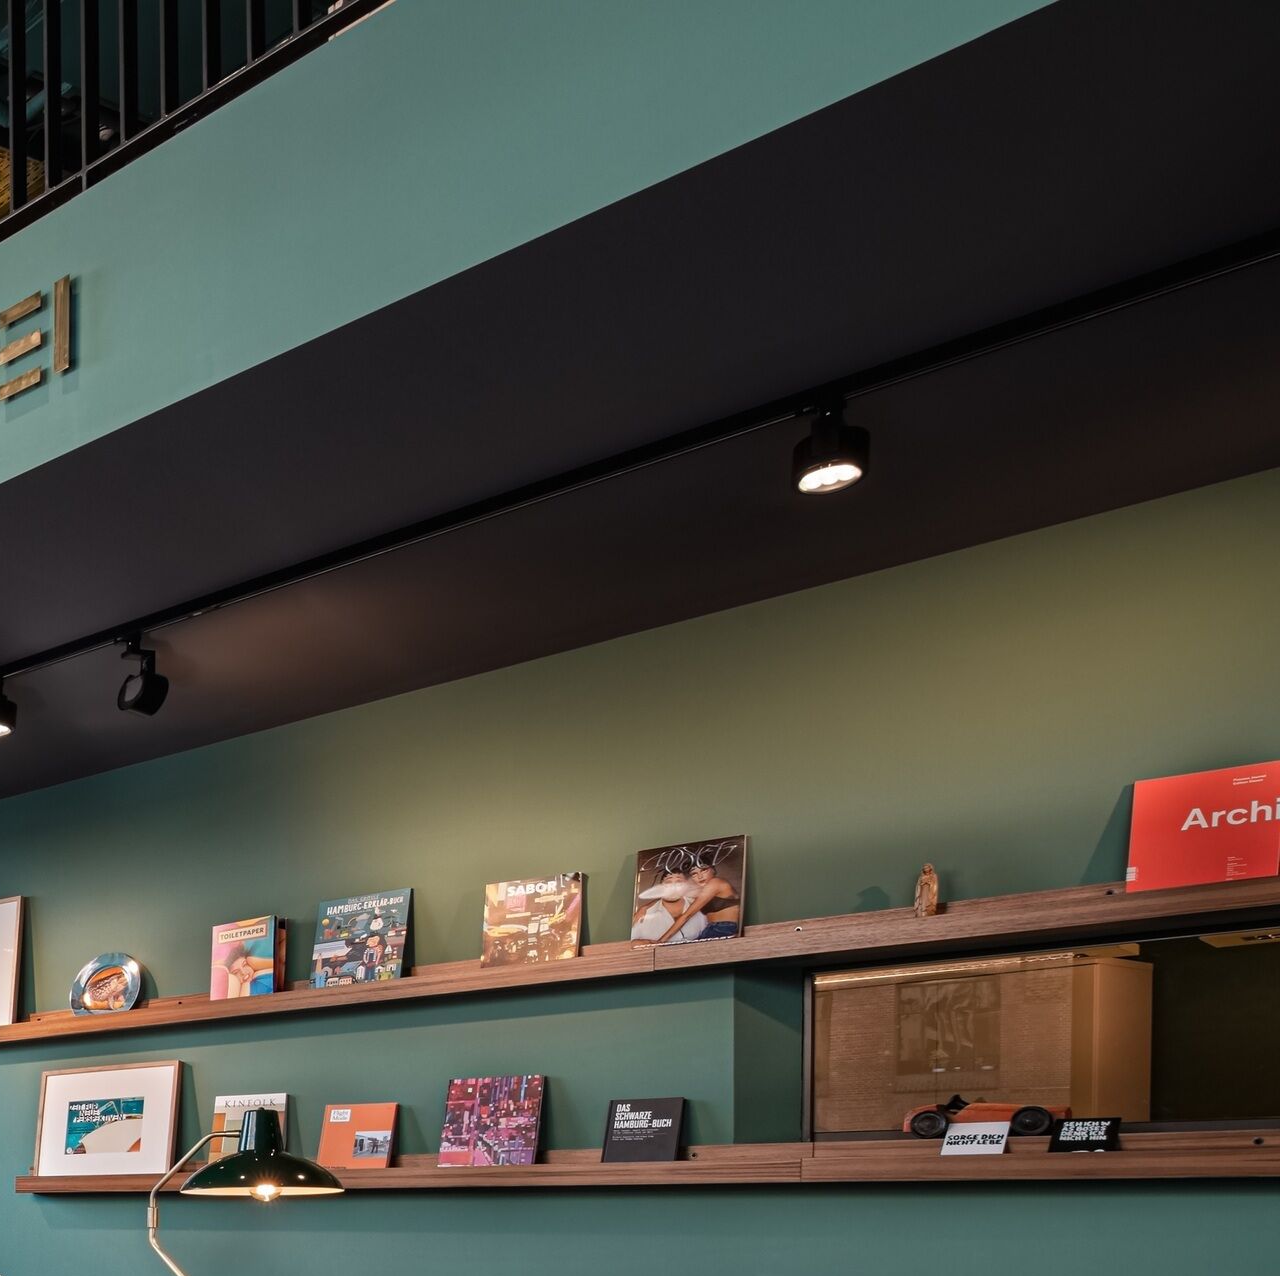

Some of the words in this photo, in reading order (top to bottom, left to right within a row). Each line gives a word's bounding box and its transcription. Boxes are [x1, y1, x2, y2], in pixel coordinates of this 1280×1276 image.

[1180, 797, 1280, 831] Archi
[507, 881, 557, 896] SABOR
[220, 927, 264, 940] TOILETPAPER
[224, 1098, 277, 1108] KINFOLK
[616, 1103, 631, 1112] DAS
[615, 1111, 652, 1121] SCHWARZE
[613, 1119, 672, 1129] HAMBURG-BUCH
